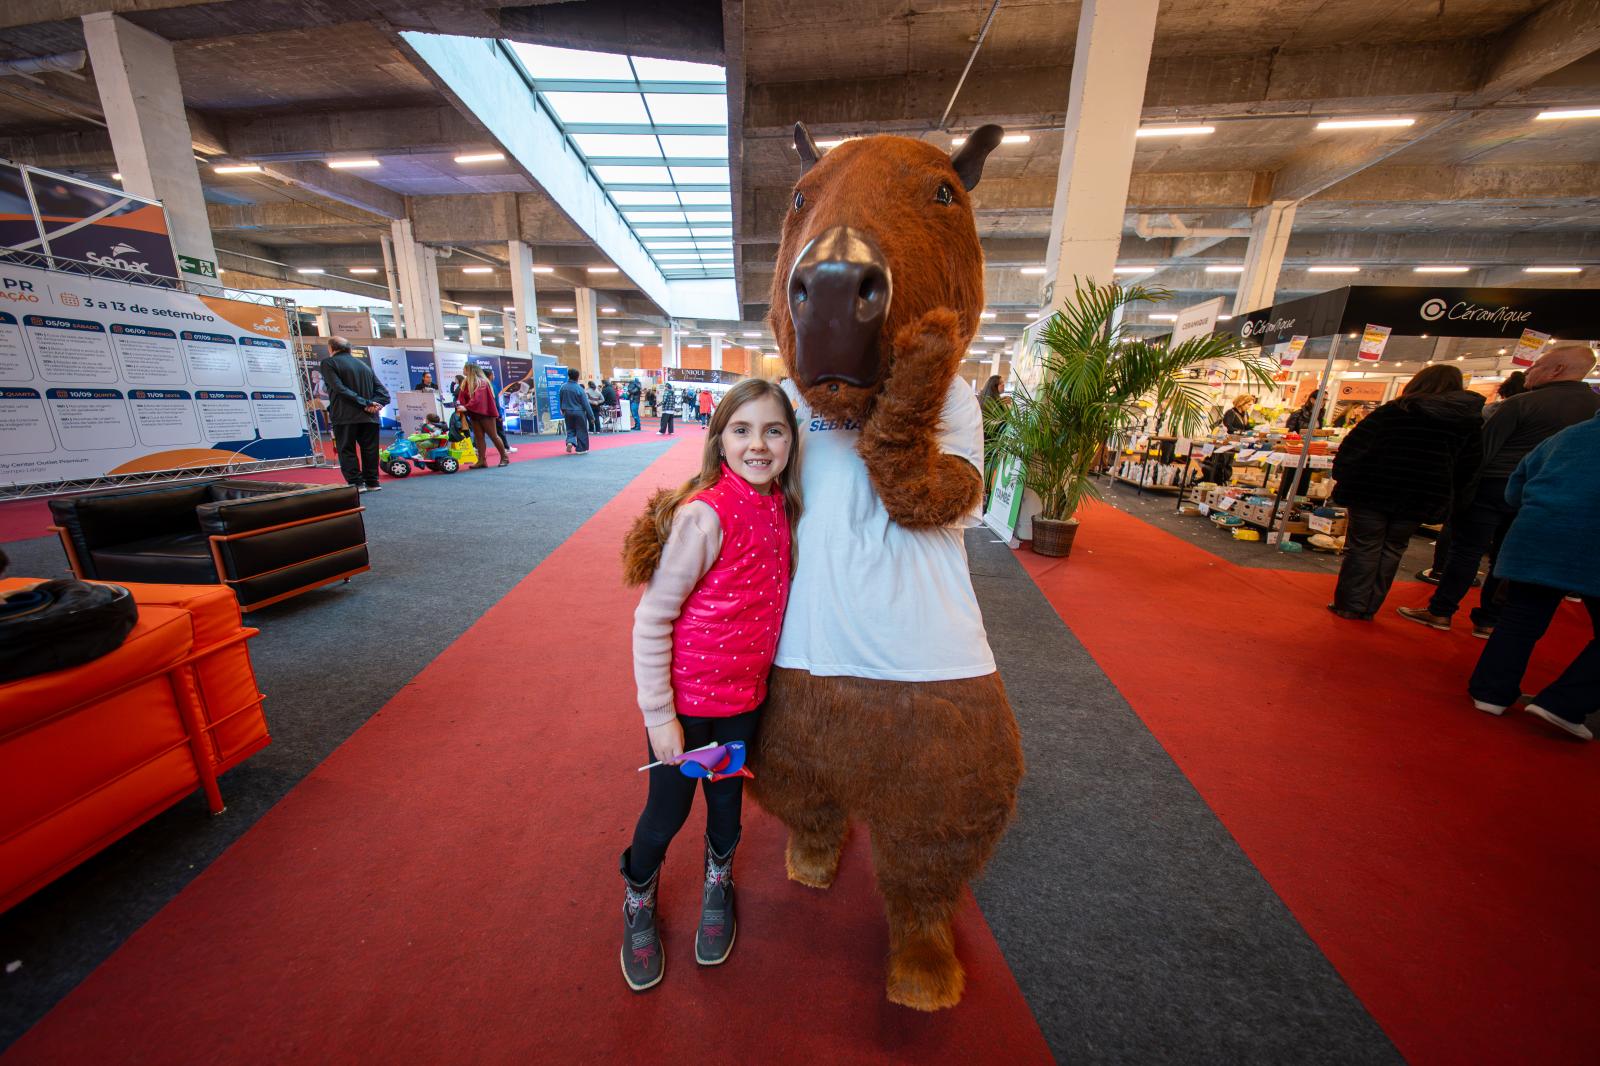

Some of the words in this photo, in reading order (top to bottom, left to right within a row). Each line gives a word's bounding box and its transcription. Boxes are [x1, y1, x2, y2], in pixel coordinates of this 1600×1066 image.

[86, 251, 150, 275] Senac
[2, 278, 34, 293] PR
[83, 297, 94, 308] 3
[98, 300, 107, 310] a
[110, 301, 127, 312] 13
[129, 304, 149, 314] de
[151, 308, 215, 323] setembro
[45, 320, 71, 328] 05/09
[253, 323, 280, 334] Senac
[124, 327, 146, 335] 06/09
[70, 390, 92, 398] 10/09
